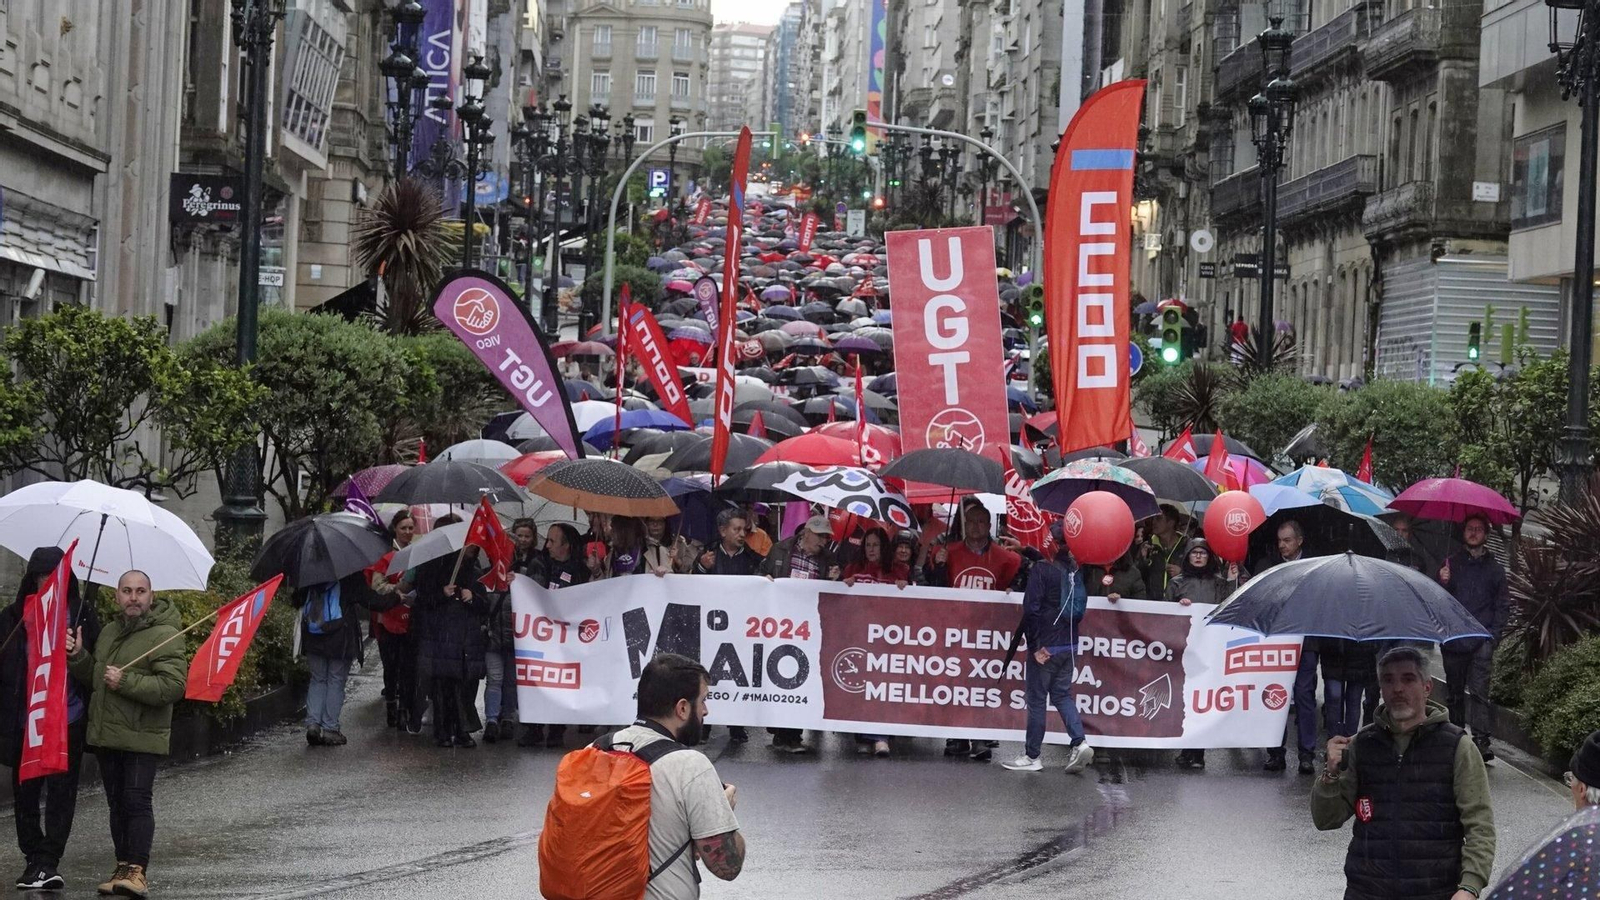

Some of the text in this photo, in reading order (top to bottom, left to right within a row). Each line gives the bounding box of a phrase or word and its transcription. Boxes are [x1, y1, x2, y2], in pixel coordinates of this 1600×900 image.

[652, 171, 667, 188] P
[182, 198, 241, 213] Peregrinus
[1077, 191, 1118, 389] CCOO
[918, 236, 971, 406] UGT
[635, 319, 682, 406] CCOO
[1004, 472, 1034, 504] UG
[960, 574, 994, 590] UGT
[512, 611, 571, 644] UGT
[745, 616, 811, 641] 2024
[867, 623, 938, 647] POLO
[866, 652, 962, 678] MENOS
[1229, 649, 1297, 670] CCOO
[515, 663, 577, 685] CCOO
[742, 693, 808, 704] #1MAIO2024
[864, 681, 1002, 708] MELLORES
[1192, 684, 1256, 715] UGT
